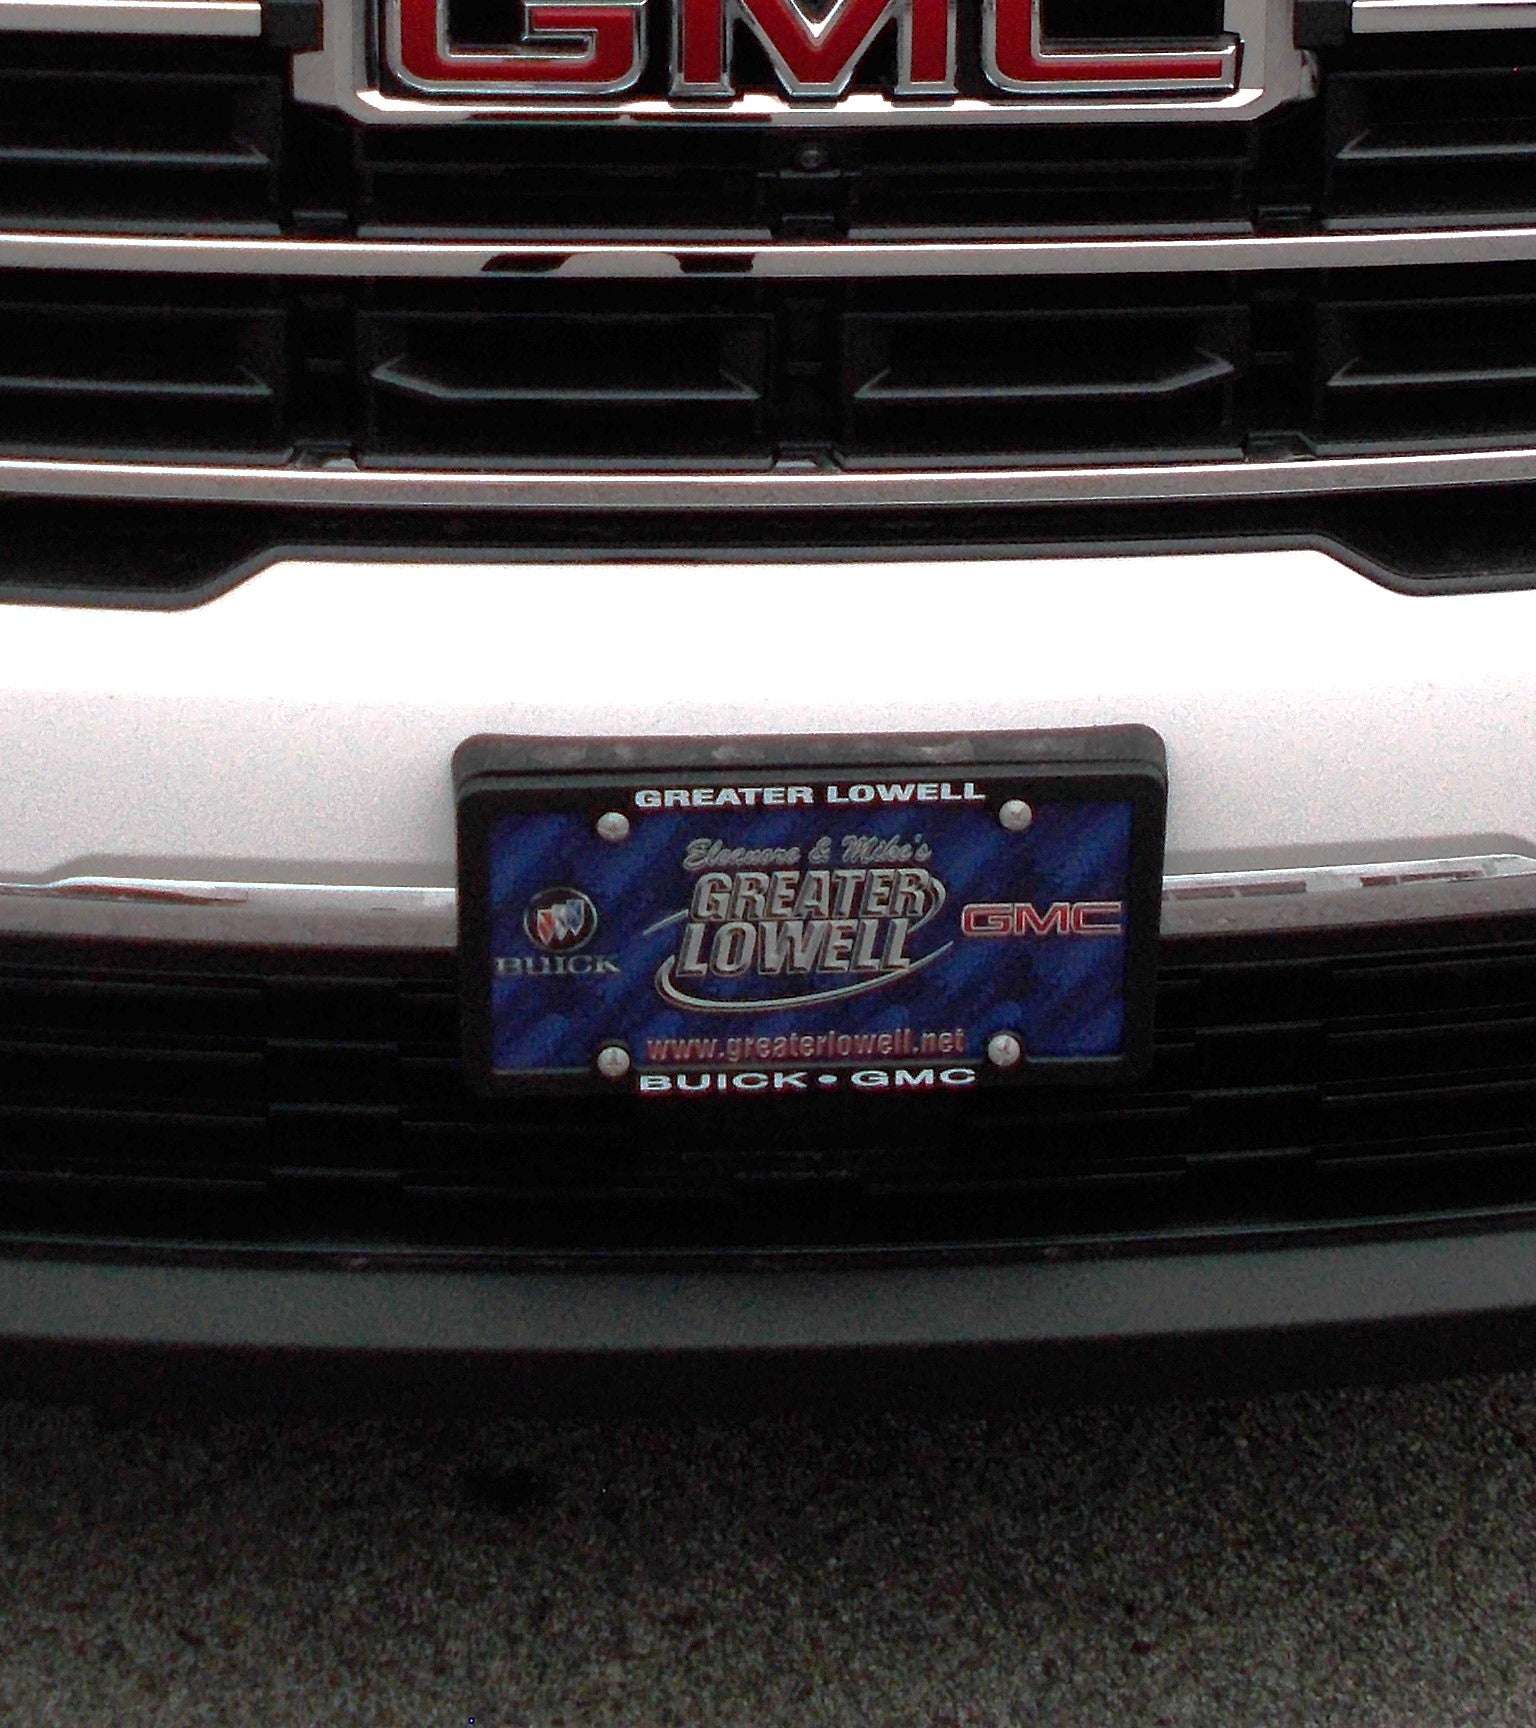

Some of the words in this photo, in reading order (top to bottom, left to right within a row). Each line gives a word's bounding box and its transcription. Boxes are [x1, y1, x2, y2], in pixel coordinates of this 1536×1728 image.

[634, 785, 815, 809] GREATER
[825, 781, 987, 805] LOWELL
[808, 834, 833, 865] &
[840, 832, 933, 866] Mike's
[689, 868, 934, 922] GREATER
[961, 901, 1123, 936] GMC
[494, 953, 620, 975] BUICK
[675, 918, 912, 977] LOWELL
[646, 1027, 966, 1063] www.greaterlowell.net
[638, 1071, 809, 1092] BUICK
[850, 1067, 977, 1089] GMC
